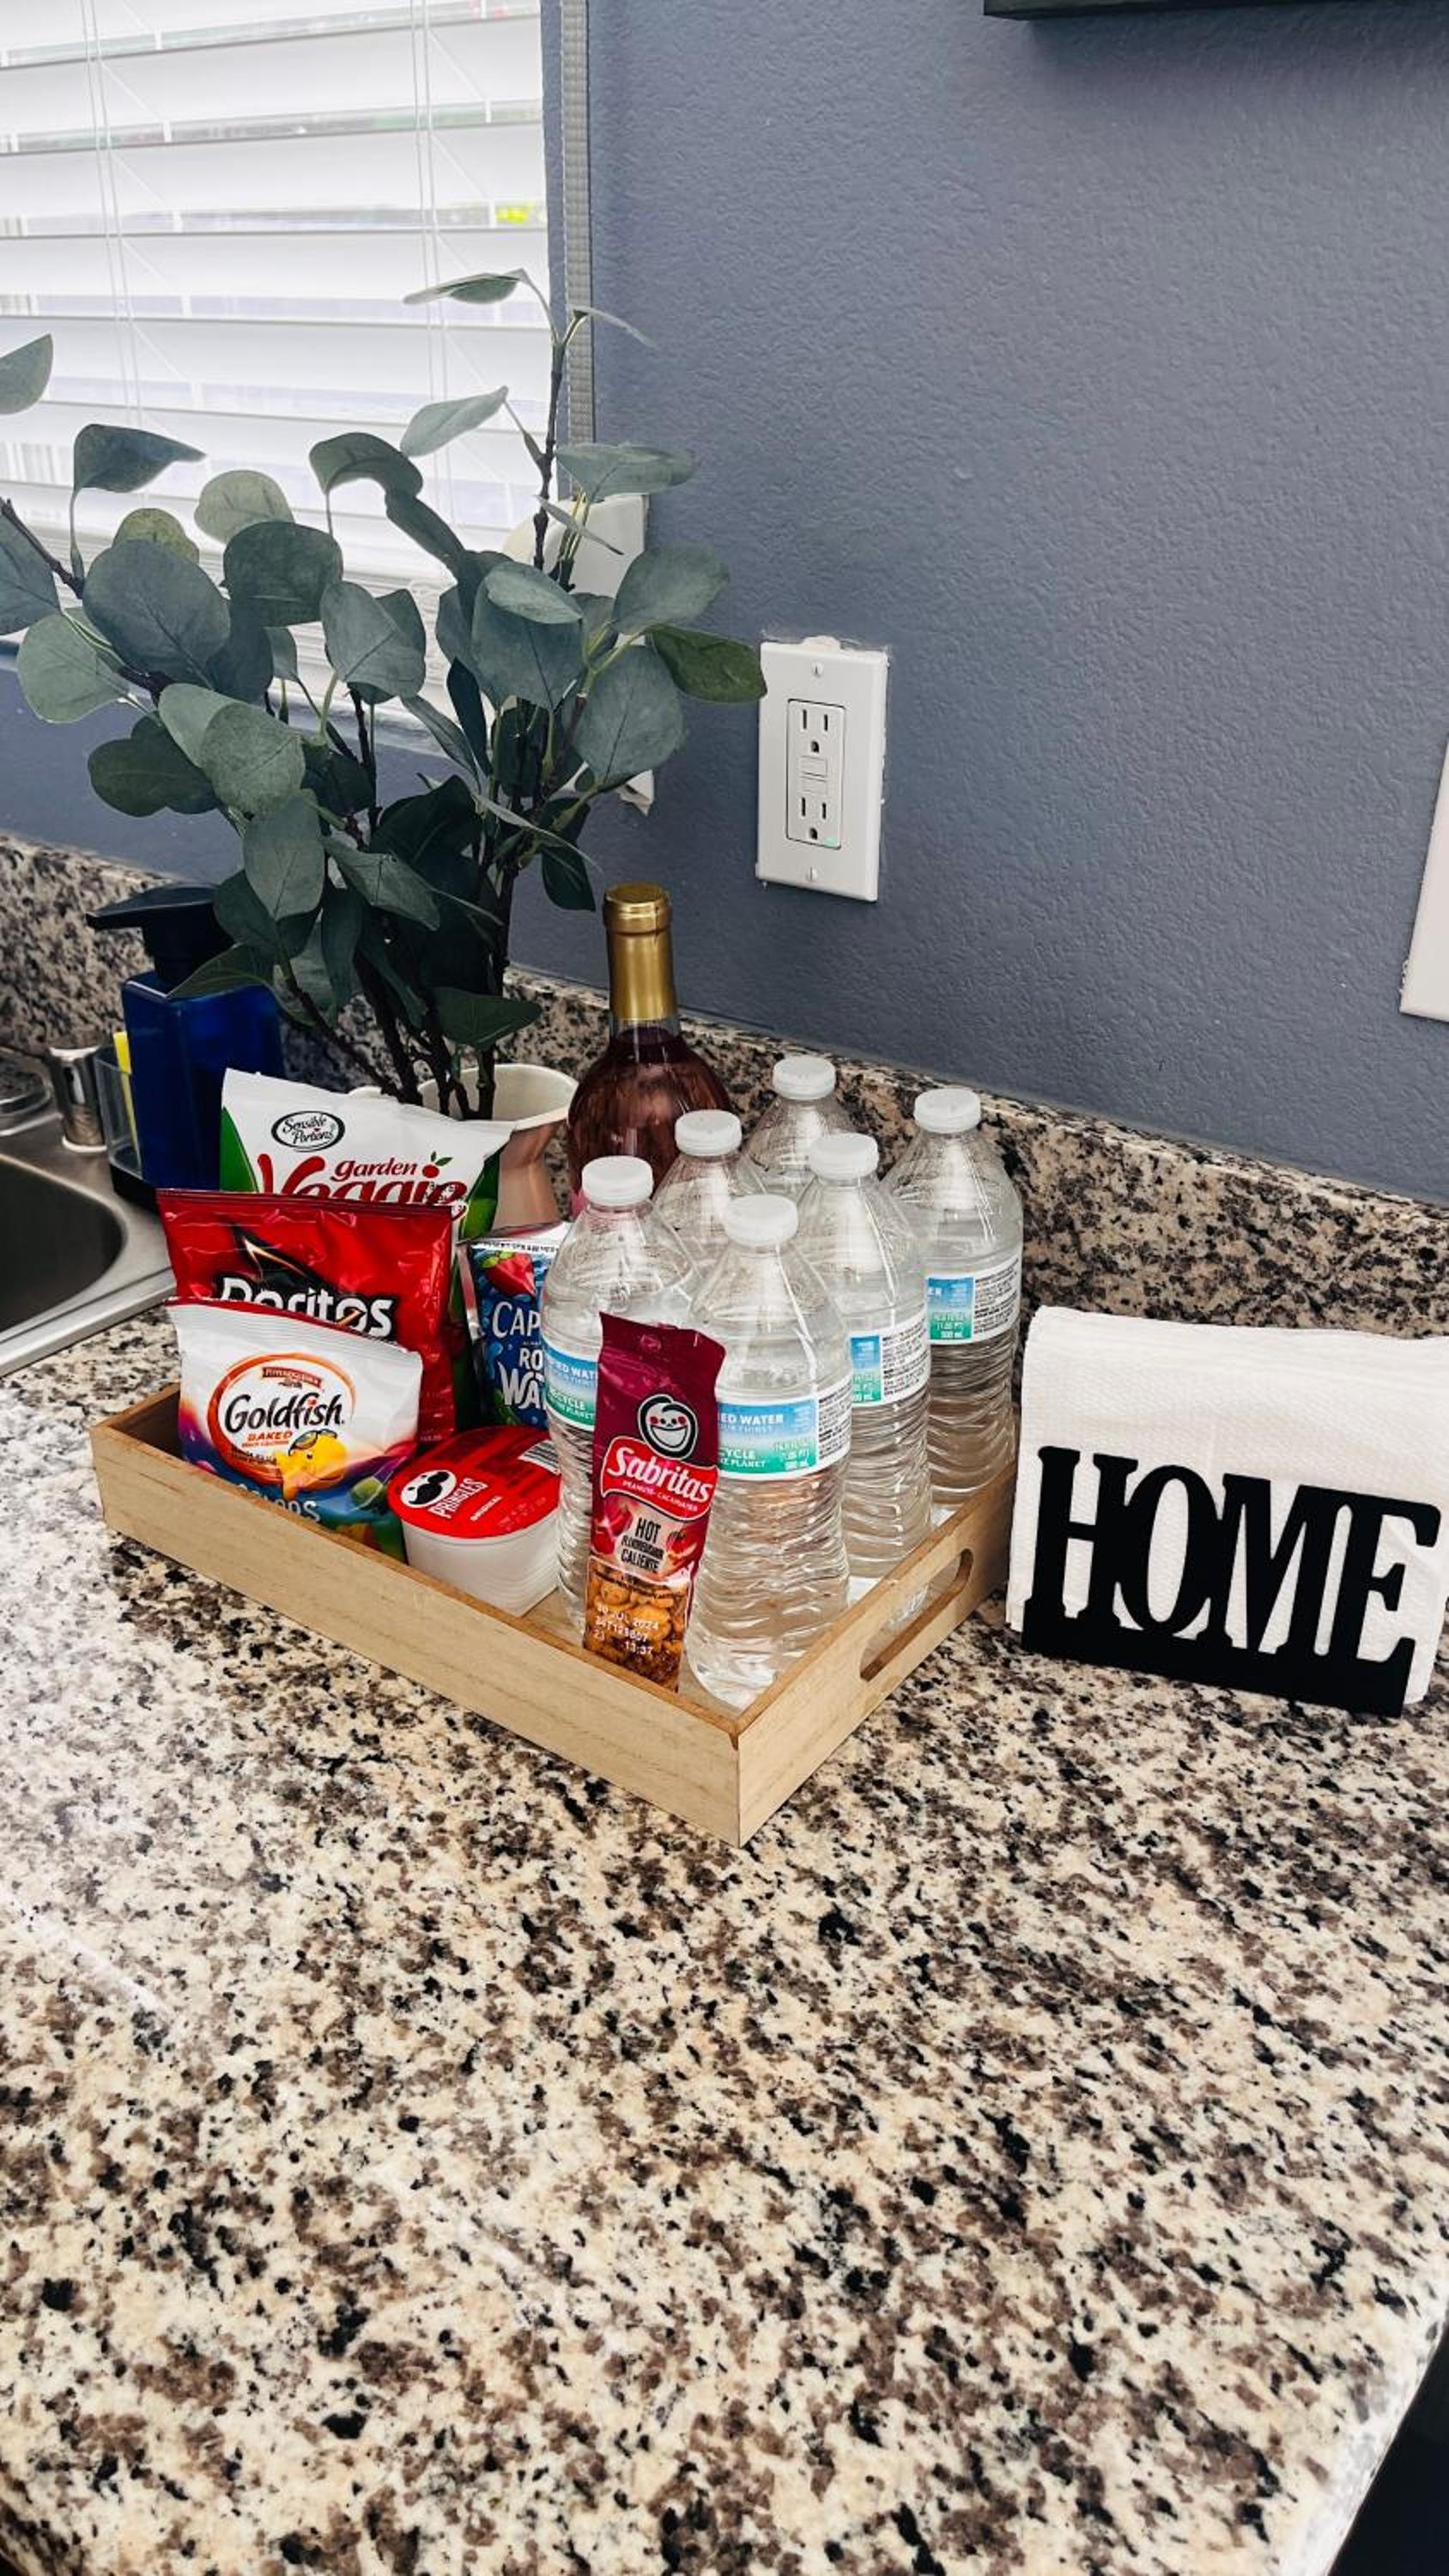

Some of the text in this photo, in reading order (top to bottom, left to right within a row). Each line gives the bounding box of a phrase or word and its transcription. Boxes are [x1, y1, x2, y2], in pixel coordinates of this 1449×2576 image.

[282, 1115, 328, 1134] Sensible
[292, 1127, 334, 1145] Portions
[330, 1157, 417, 1182] garden
[492, 1301, 541, 1339] CAP
[518, 1347, 543, 1370] RO
[497, 1361, 543, 1409] WA
[571, 1367, 597, 1381] WAT
[224, 1392, 343, 1434] Goldfish
[719, 1413, 784, 1425] ED WATER
[246, 1430, 293, 1443] BAKED
[606, 1446, 713, 1503] Sabritas
[427, 1477, 488, 1519] PRINGLES
[634, 1517, 662, 1543] HOT
[1025, 1446, 1441, 1687] HOME
